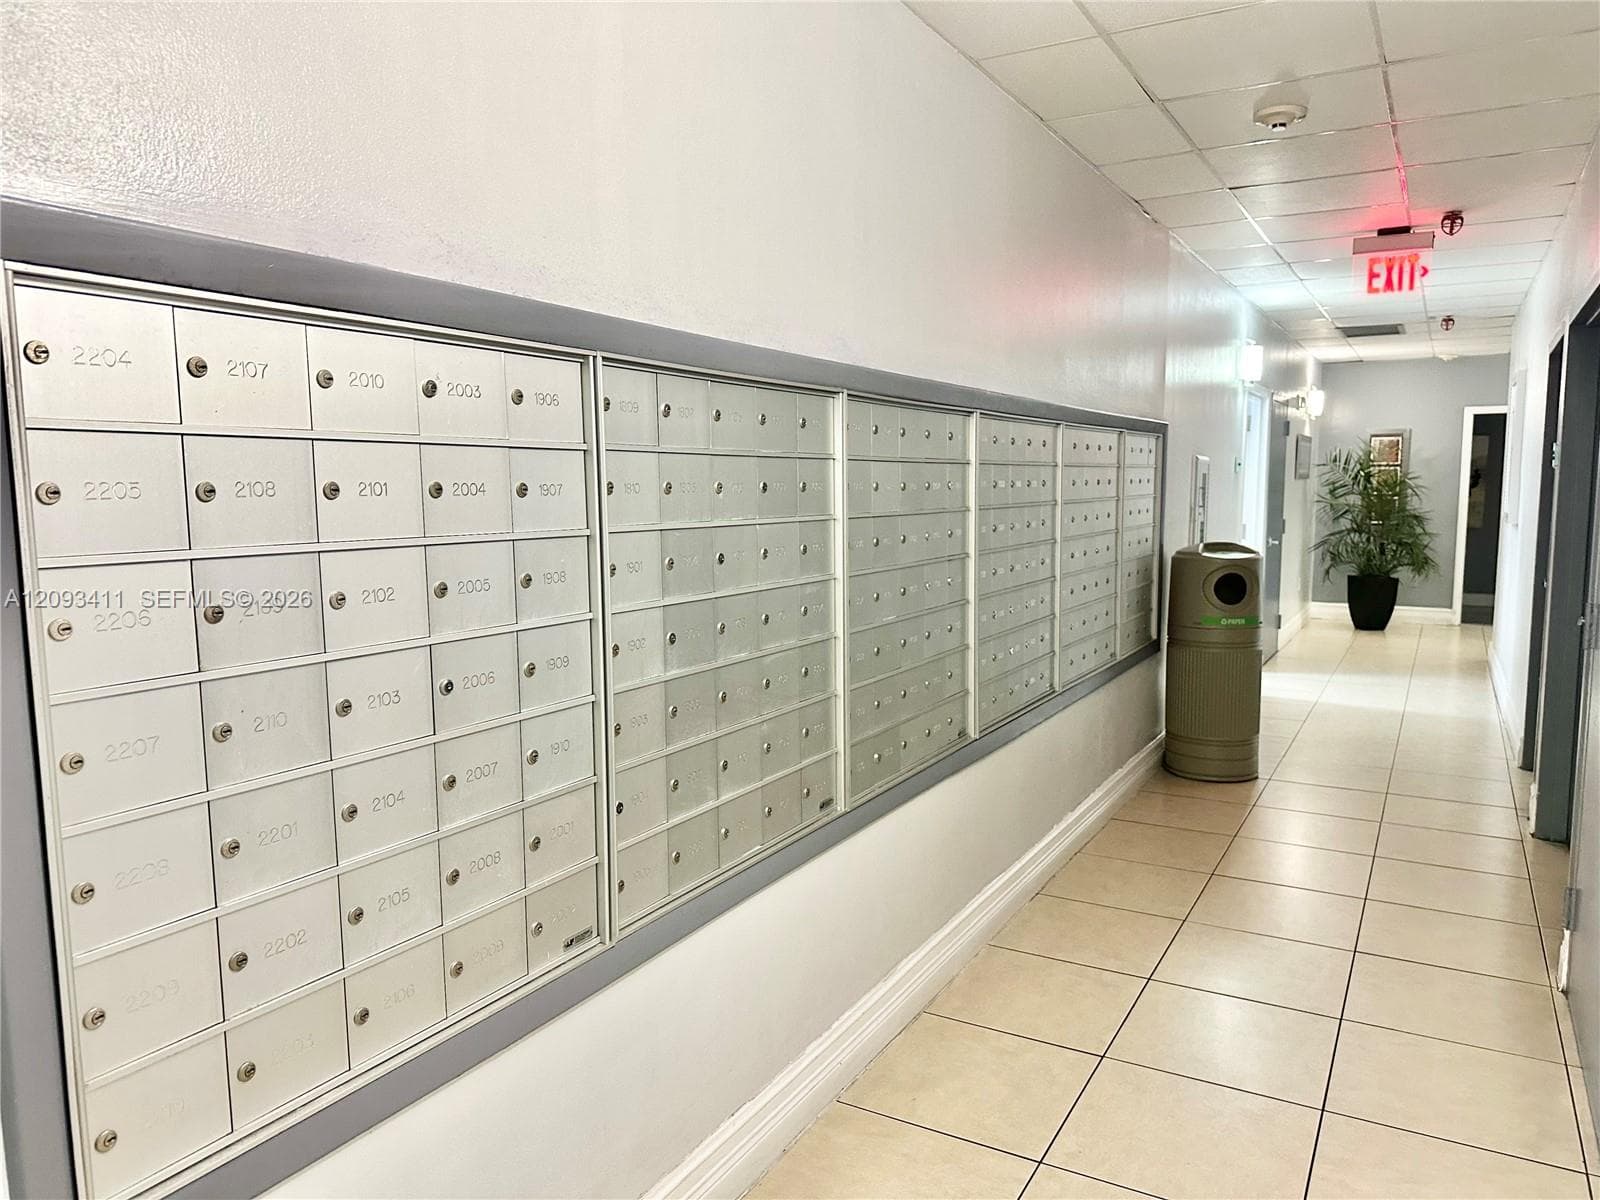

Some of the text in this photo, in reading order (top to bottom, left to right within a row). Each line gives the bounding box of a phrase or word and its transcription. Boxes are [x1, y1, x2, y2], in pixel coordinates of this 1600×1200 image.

[1367, 253, 1420, 294] EXIT
[72, 345, 132, 369] 2204
[226, 359, 269, 380] 2107
[348, 371, 385, 390] 2010
[446, 381, 482, 399] 2003
[534, 391, 560, 407] 1906
[83, 481, 143, 502] 2205
[234, 480, 277, 499] 2108
[358, 482, 389, 498] 2101
[452, 482, 487, 498] 2004
[538, 483, 563, 498] 1907
[457, 578, 491, 595] 2005
[542, 570, 567, 586] 1908
[361, 586, 396, 605] 2102
[94, 609, 152, 633] 2206
[545, 655, 570, 671] 1909
[462, 671, 496, 690] 2006
[367, 689, 402, 710] 2103
[253, 711, 288, 733] 2110
[104, 736, 160, 762] 2207
[465, 761, 499, 783] 2007
[372, 789, 406, 813] 2104
[257, 822, 299, 848] 2201
[469, 851, 502, 874] 2008
[377, 887, 411, 912] 2105
[264, 929, 308, 960] 2202
[383, 983, 416, 1011] 2106
